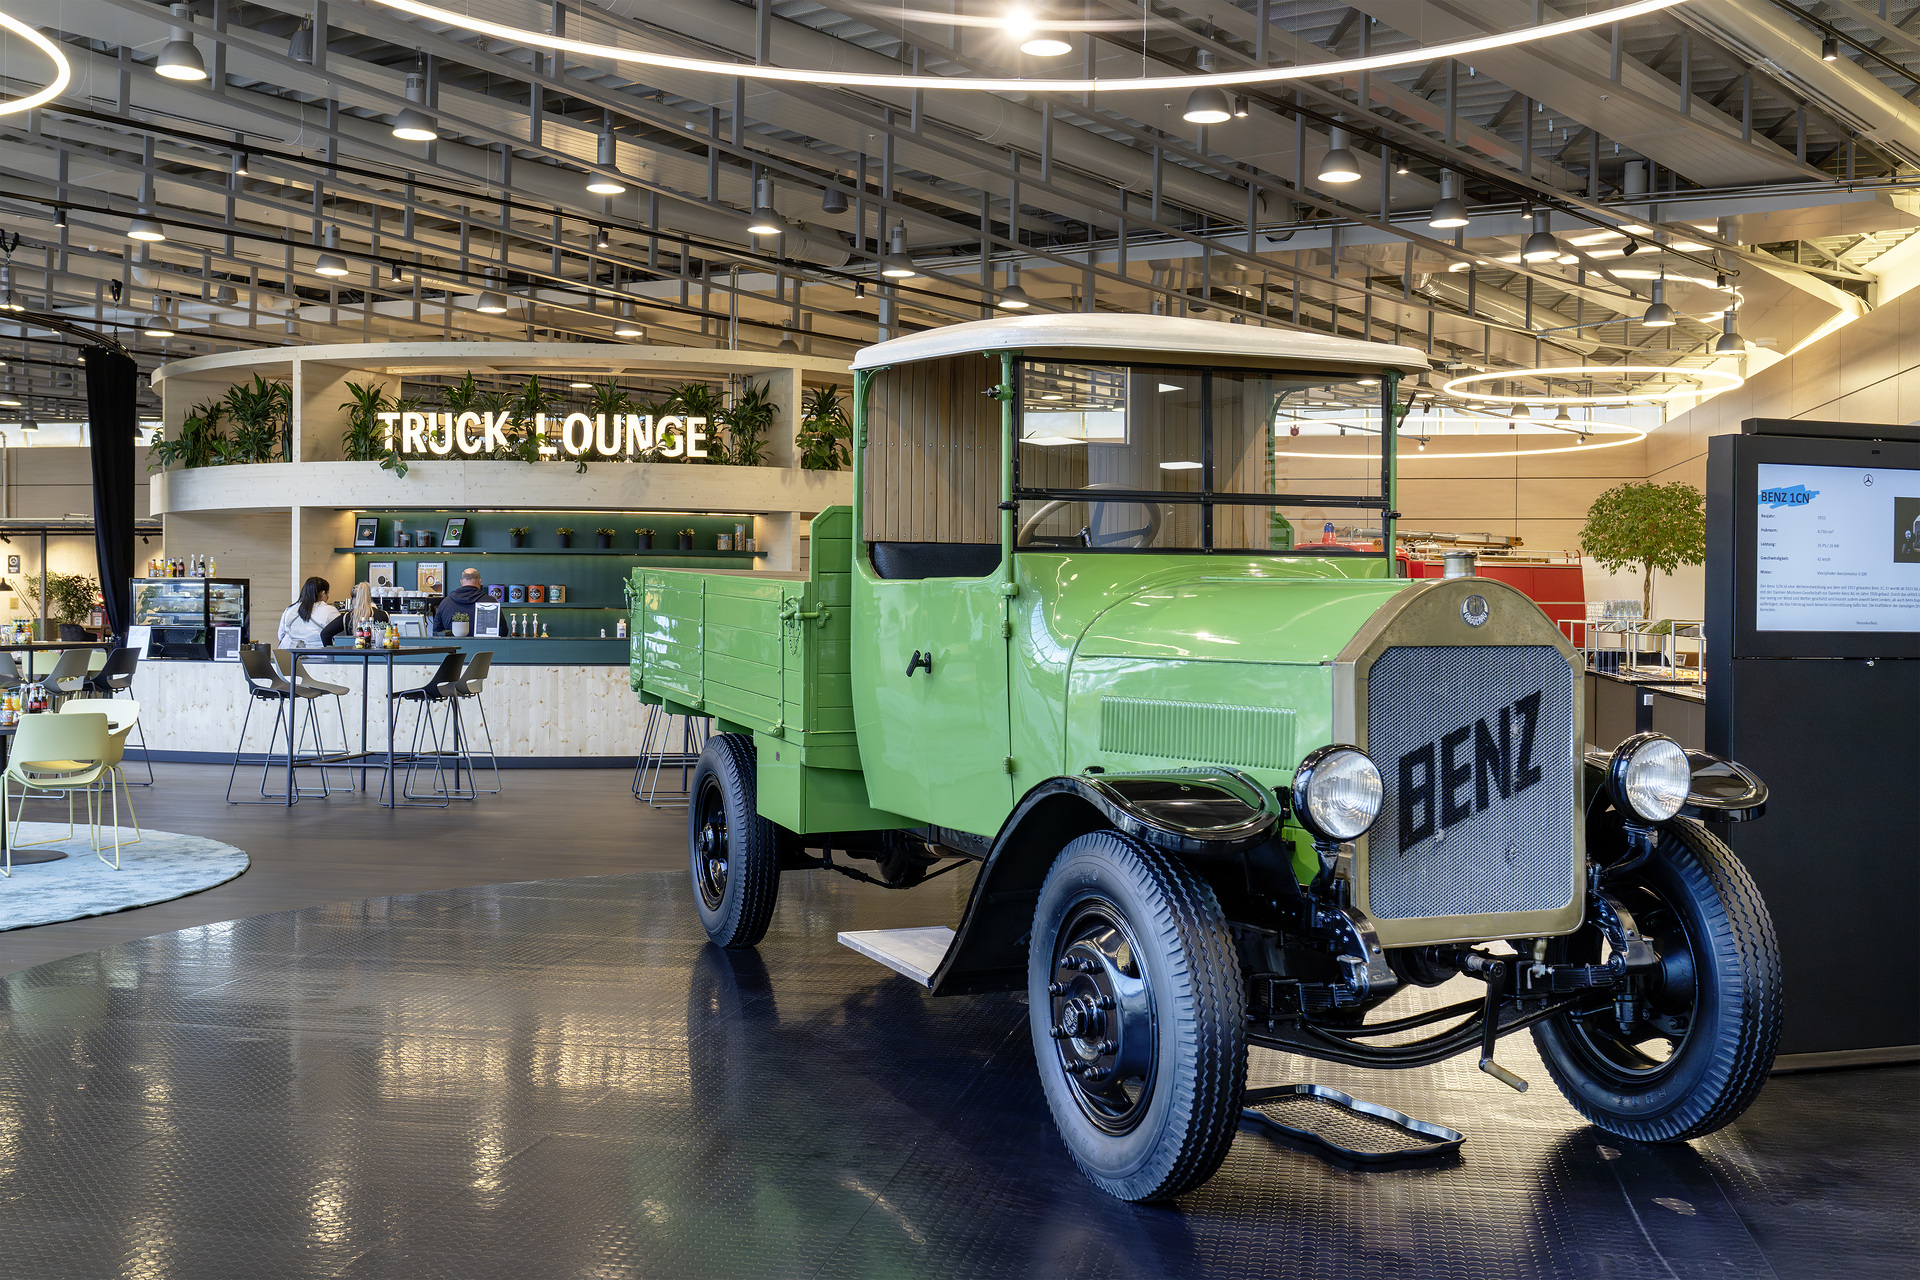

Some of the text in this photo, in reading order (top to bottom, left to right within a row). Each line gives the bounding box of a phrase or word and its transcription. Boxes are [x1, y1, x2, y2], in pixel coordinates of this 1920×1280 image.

[377, 411, 708, 458] TRUCK LOUNGE
[1761, 491, 1810, 504] BENZ 1CN
[1399, 688, 1542, 856] BENZ
